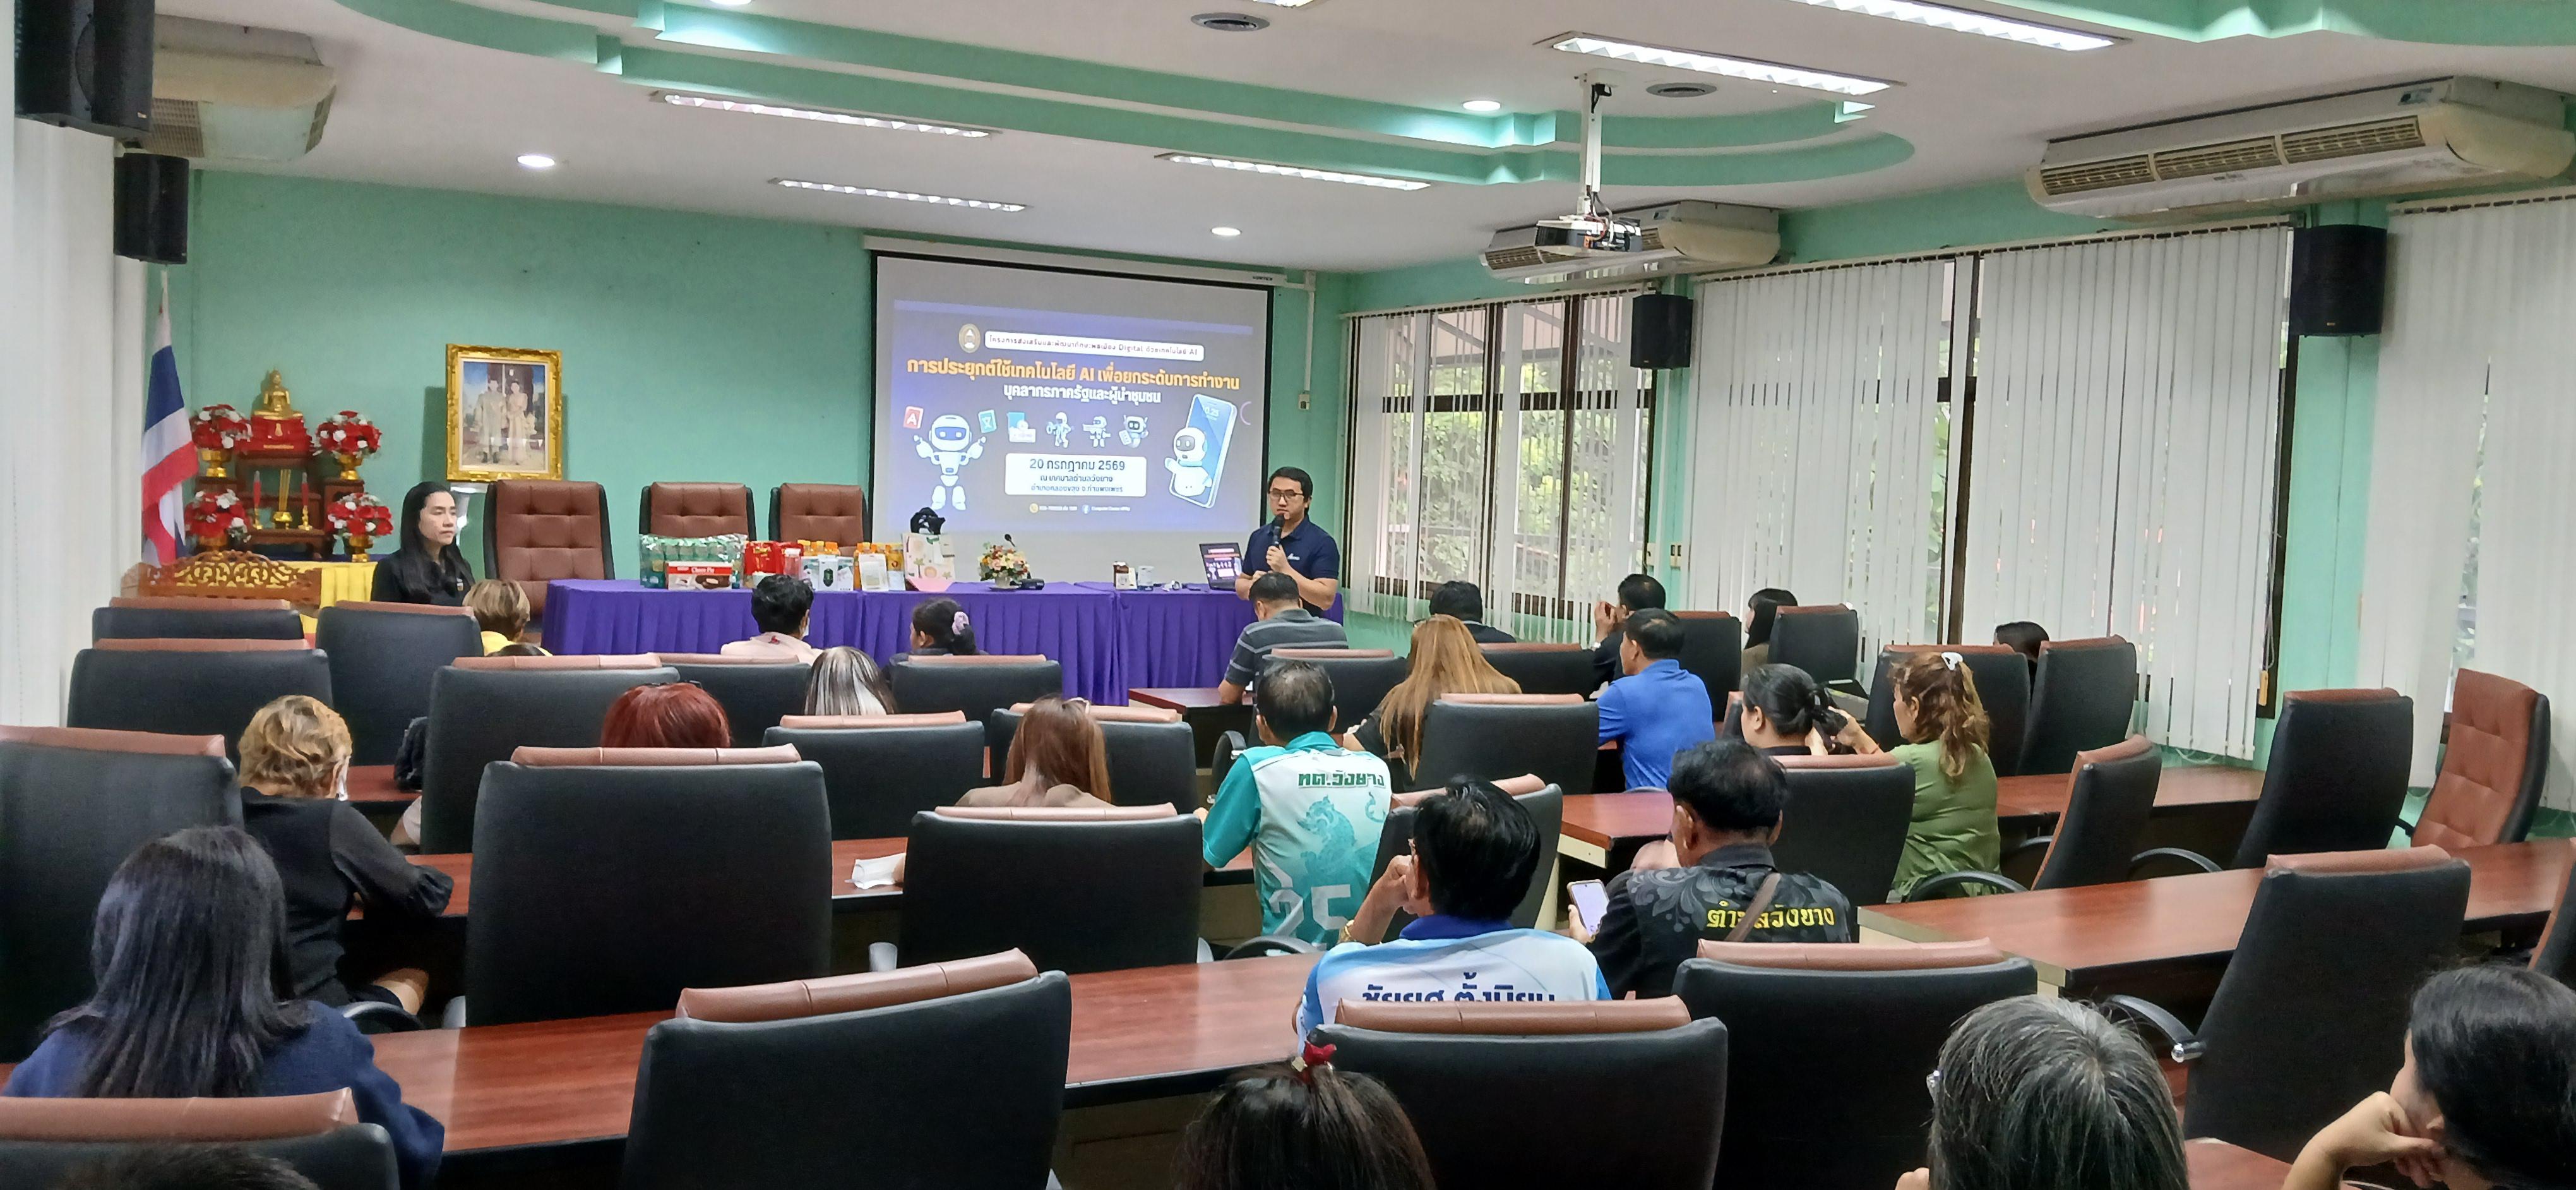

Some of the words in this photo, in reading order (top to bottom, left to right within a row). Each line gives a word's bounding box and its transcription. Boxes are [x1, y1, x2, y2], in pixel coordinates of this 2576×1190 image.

[1119, 343, 1143, 352] Digital
[907, 358, 1076, 381] การประยุกต์ใช้เทคโนโลยี
[1080, 367, 1094, 381] AI
[1098, 362, 1241, 390] เพื่อยกระดับการทำงาน
[1003, 383, 1162, 406] บุคลากรภาครัฐและผู้นำชุมชน
[1030, 459, 1044, 469] 20
[1047, 460, 1095, 472] กรกฎาคม
[1098, 460, 1125, 470] 2569
[1298, 769, 1385, 786] ทต.วังยาง
